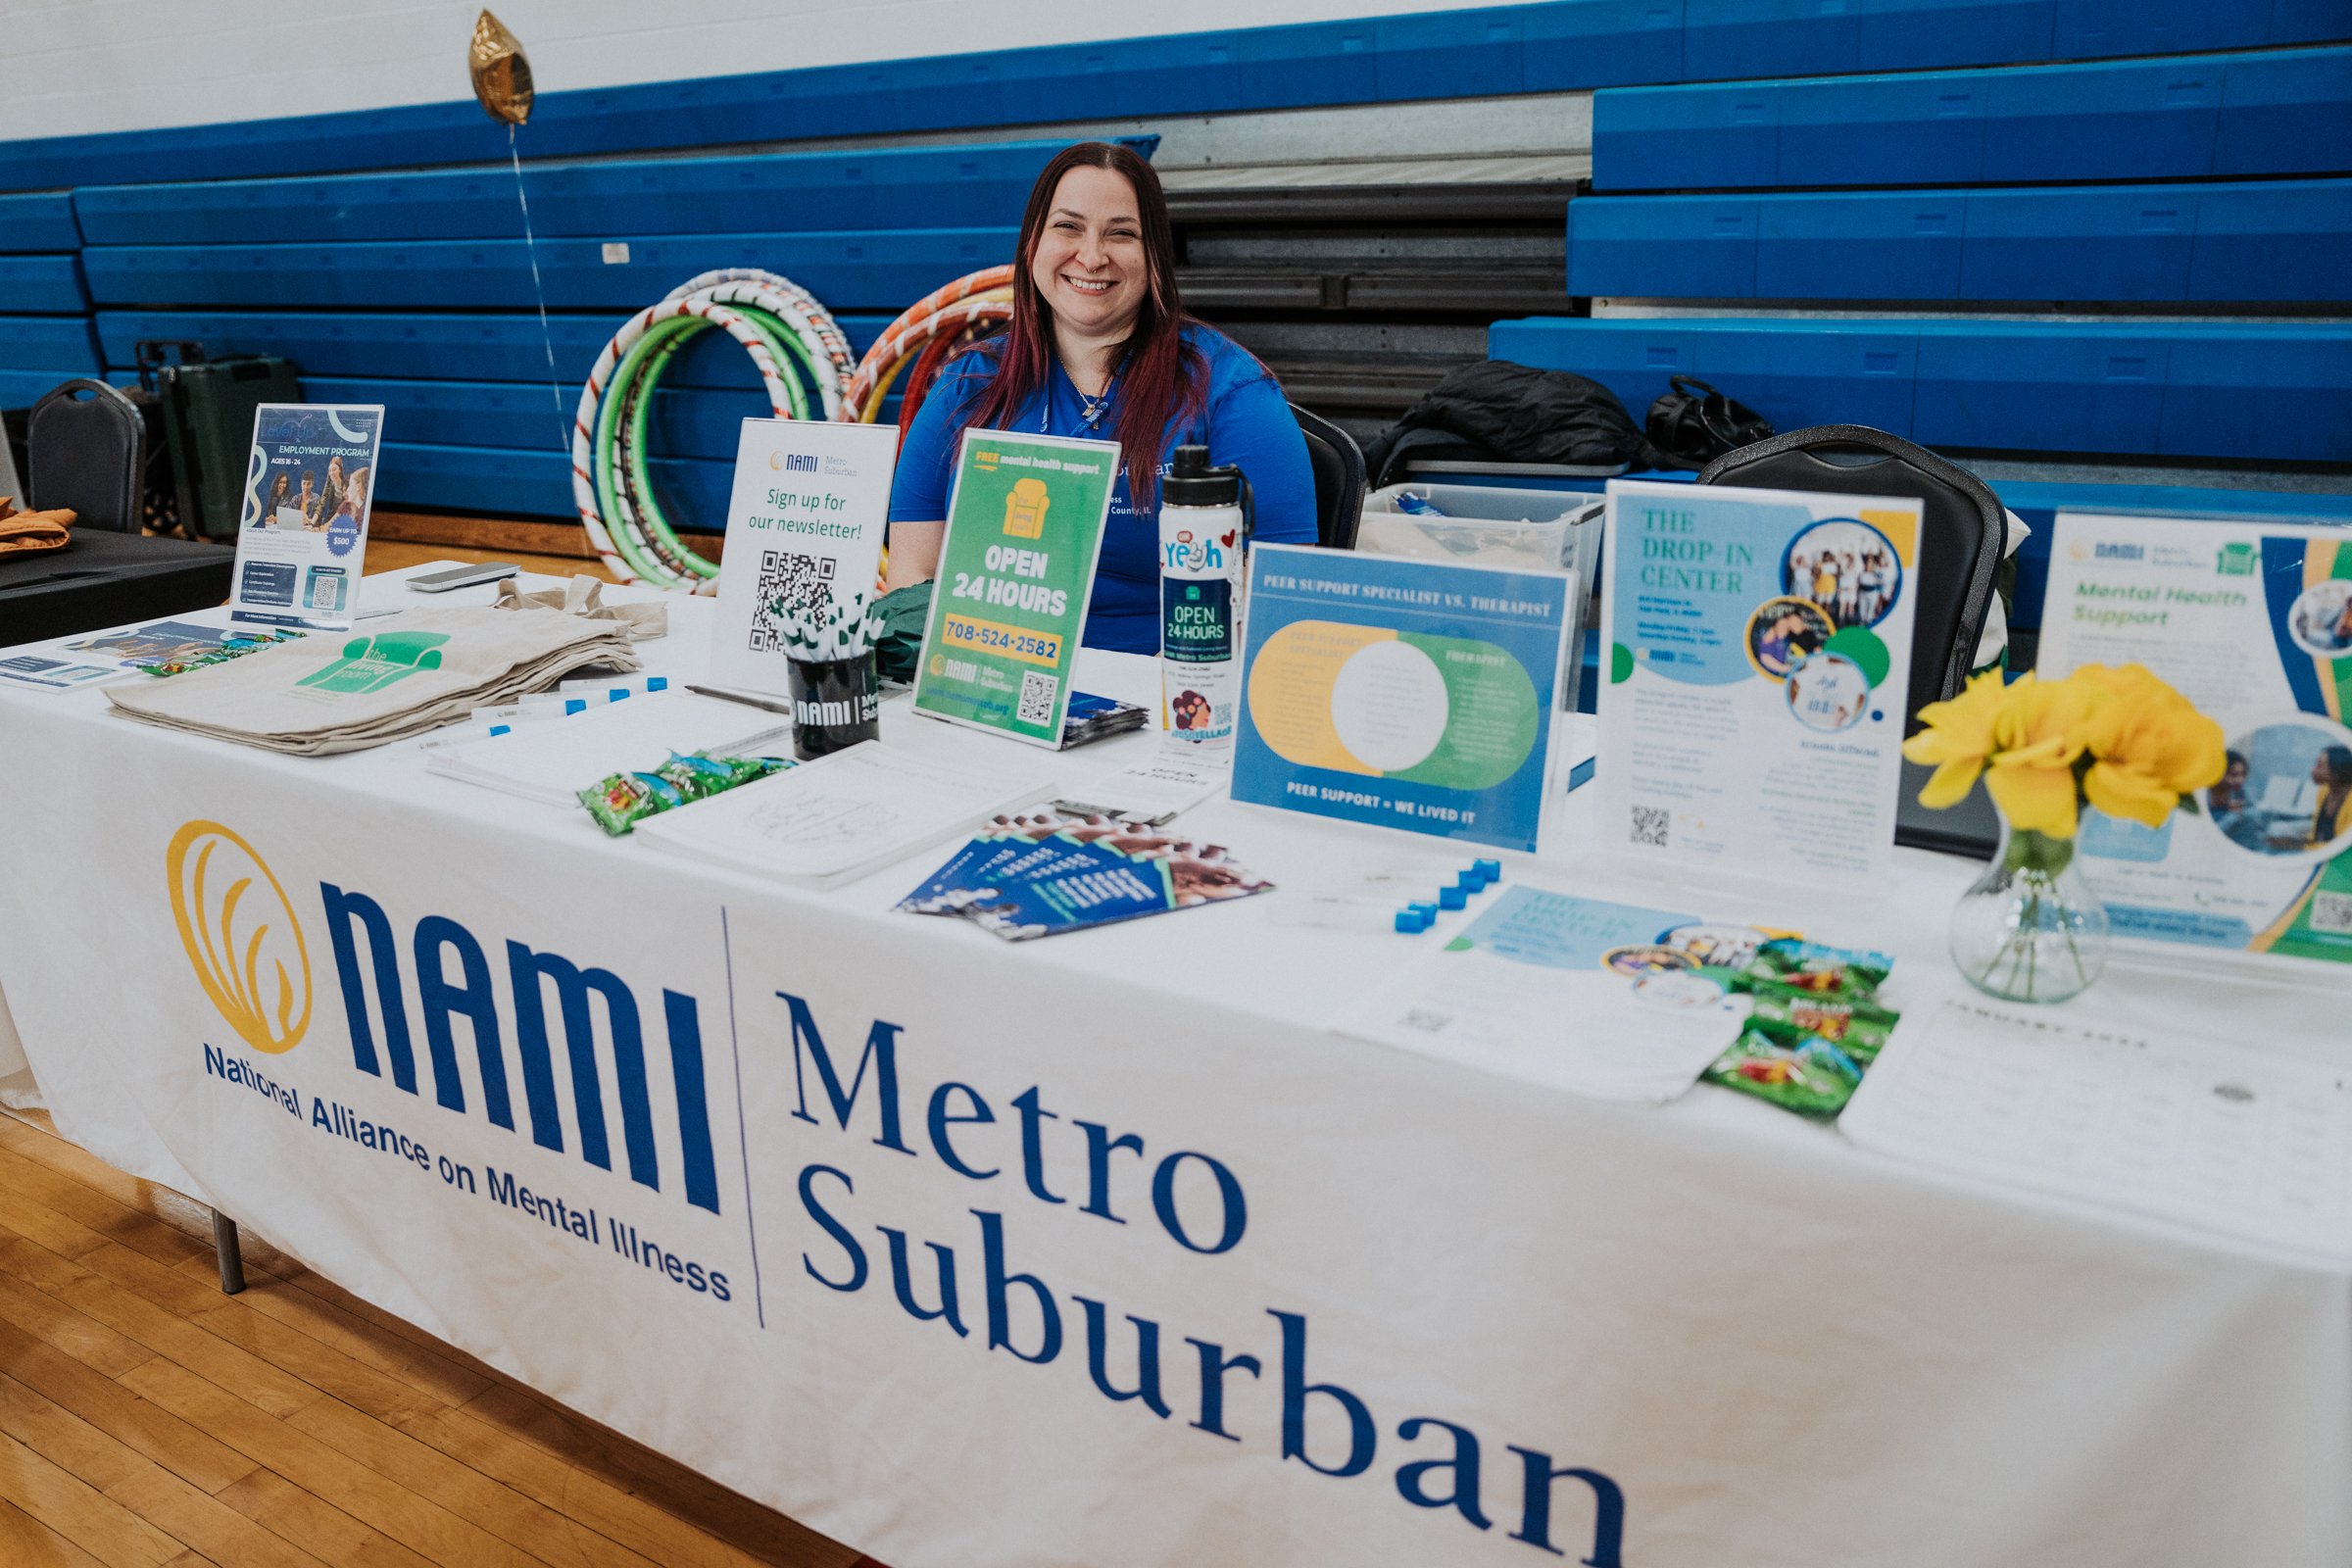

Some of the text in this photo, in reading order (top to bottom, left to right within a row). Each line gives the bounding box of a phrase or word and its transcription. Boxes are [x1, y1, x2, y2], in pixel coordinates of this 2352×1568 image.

[279, 445, 369, 458] EMPLOYMENT PROGRAM
[786, 454, 847, 472] NAMI Metro
[975, 451, 1100, 475] FREE mental health support
[824, 466, 858, 477] Suburban
[766, 488, 847, 513] Sign up for
[749, 515, 862, 540] our newsletter!
[1642, 508, 1696, 534] THE
[333, 537, 350, 546] $500
[1165, 539, 1223, 568] Yeh
[1642, 538, 1754, 566] DROP-IN
[985, 545, 1049, 579] OPEN
[1641, 564, 1743, 595] CENTER
[952, 572, 1068, 617] 24 HOURS
[1264, 574, 1551, 617] PEER SUPPORT SPECIALIST VS. THERAPIST
[2075, 581, 2247, 608] Mental Health
[1174, 605, 1215, 624] OPEN
[2073, 604, 2169, 630] Support
[947, 621, 1057, 659] 708-524-2582
[1167, 623, 1225, 640] 24 HOURS
[367, 648, 388, 661] the
[945, 659, 978, 683] NAMI
[797, 700, 852, 726] NAMI
[1287, 781, 1318, 798] PEER
[1320, 789, 1382, 809] SUPPORT
[1395, 800, 1415, 815] WE
[1418, 805, 1458, 823] LIVED
[1461, 811, 1476, 825] IT
[318, 880, 720, 1215] NAMI
[775, 990, 1248, 1255] Metro
[203, 1042, 732, 1302] National Alliance on Mental Illness
[796, 1163, 1627, 1568] Suburban
